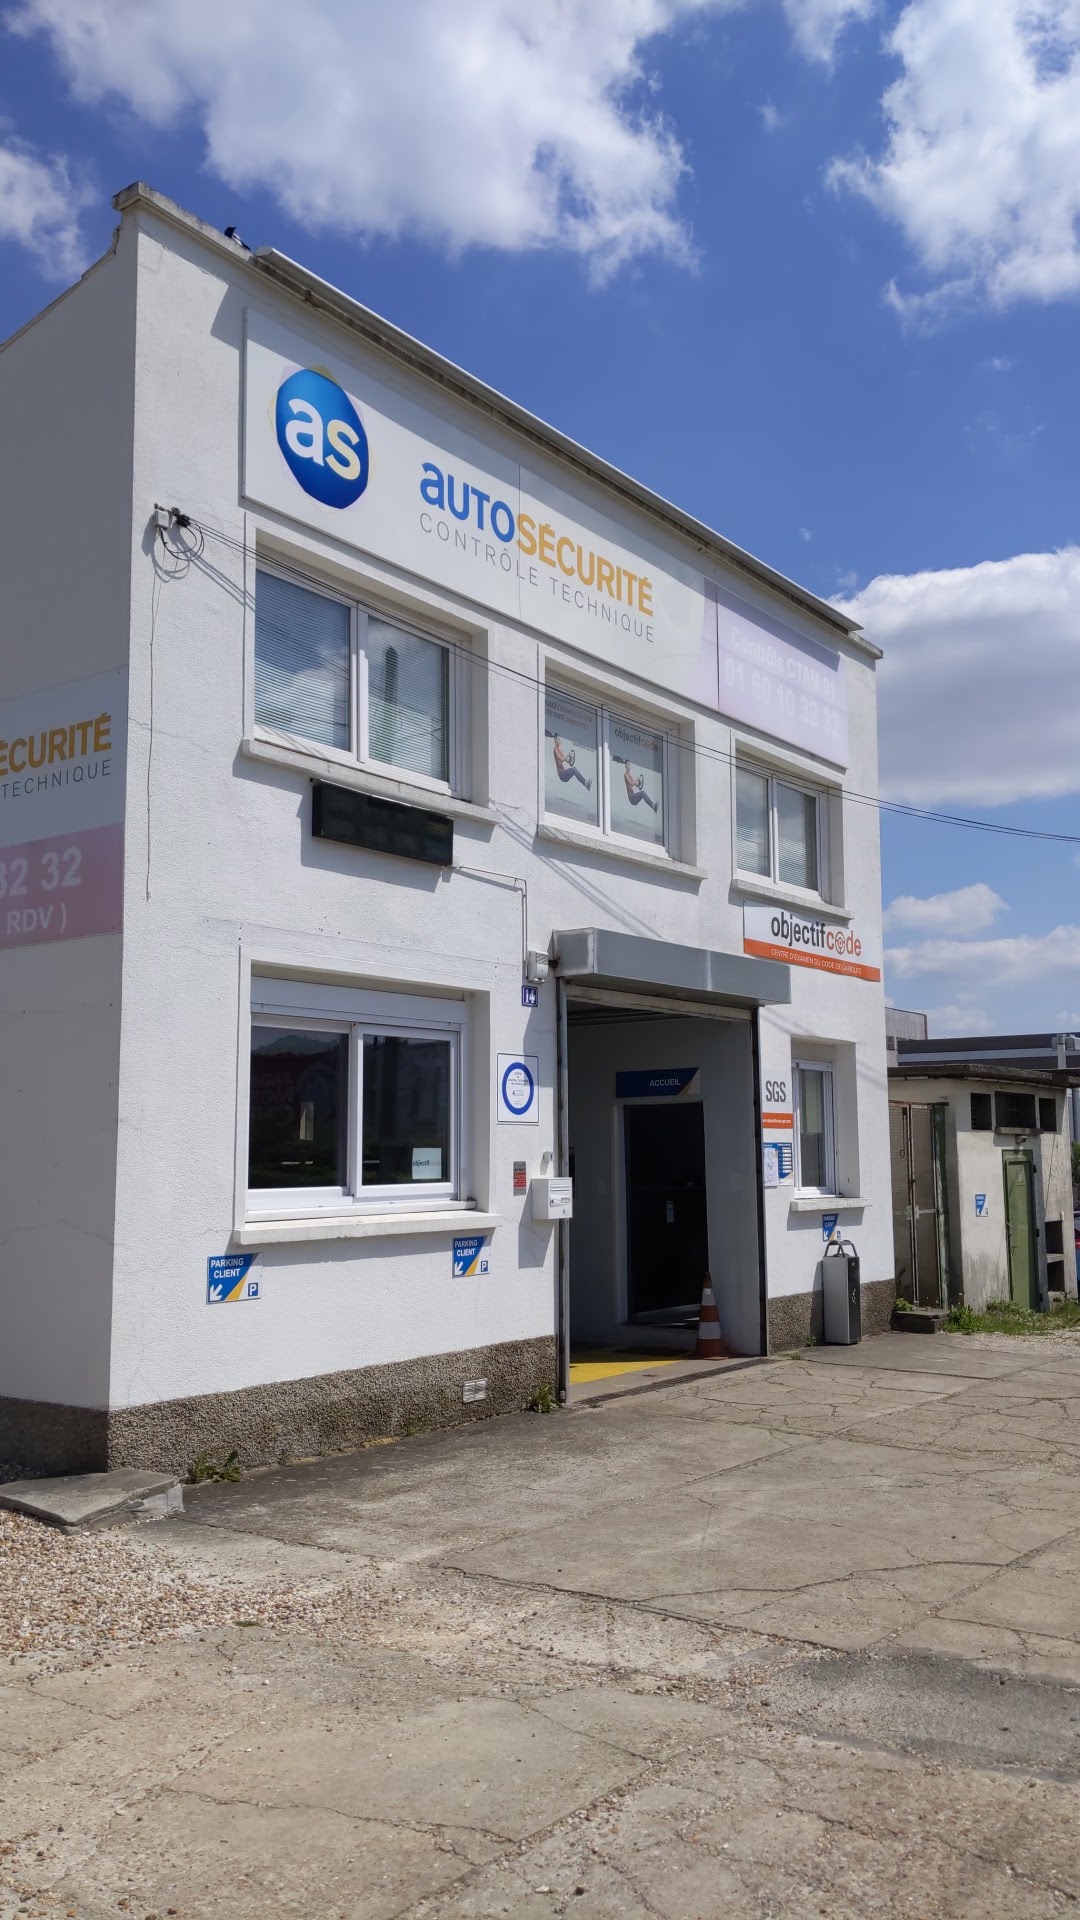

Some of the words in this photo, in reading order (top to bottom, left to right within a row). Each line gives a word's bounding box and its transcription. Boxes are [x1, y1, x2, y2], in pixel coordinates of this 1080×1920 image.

[285, 398, 361, 480] as
[420, 512, 538, 586] CONTRÔLE
[550, 576, 654, 643] TECHNIQUE
[731, 626, 784, 673] Contrôle
[725, 656, 744, 695] 01
[751, 670, 772, 705] 60
[777, 684, 795, 716] 10
[801, 698, 819, 728] 32
[823, 710, 841, 738] 32
[1, 759, 111, 799] TECHNIQUE
[40, 847, 82, 891] 32
[7, 904, 53, 936] RDV
[770, 948, 789, 959] CENTRE
[814, 958, 821, 966] DU
[821, 960, 835, 969] CODE
[847, 965, 863, 975] ROUTE
[525, 988, 536, 1004] 14
[649, 1078, 681, 1087] ACCUEIL
[765, 1080, 787, 1103] SGS
[454, 1240, 478, 1248] PARKING
[456, 1248, 476, 1257] CLIENT
[211, 1257, 244, 1268] PARKING
[213, 1268, 241, 1278] CLIENT
[249, 1284, 257, 1296] P
